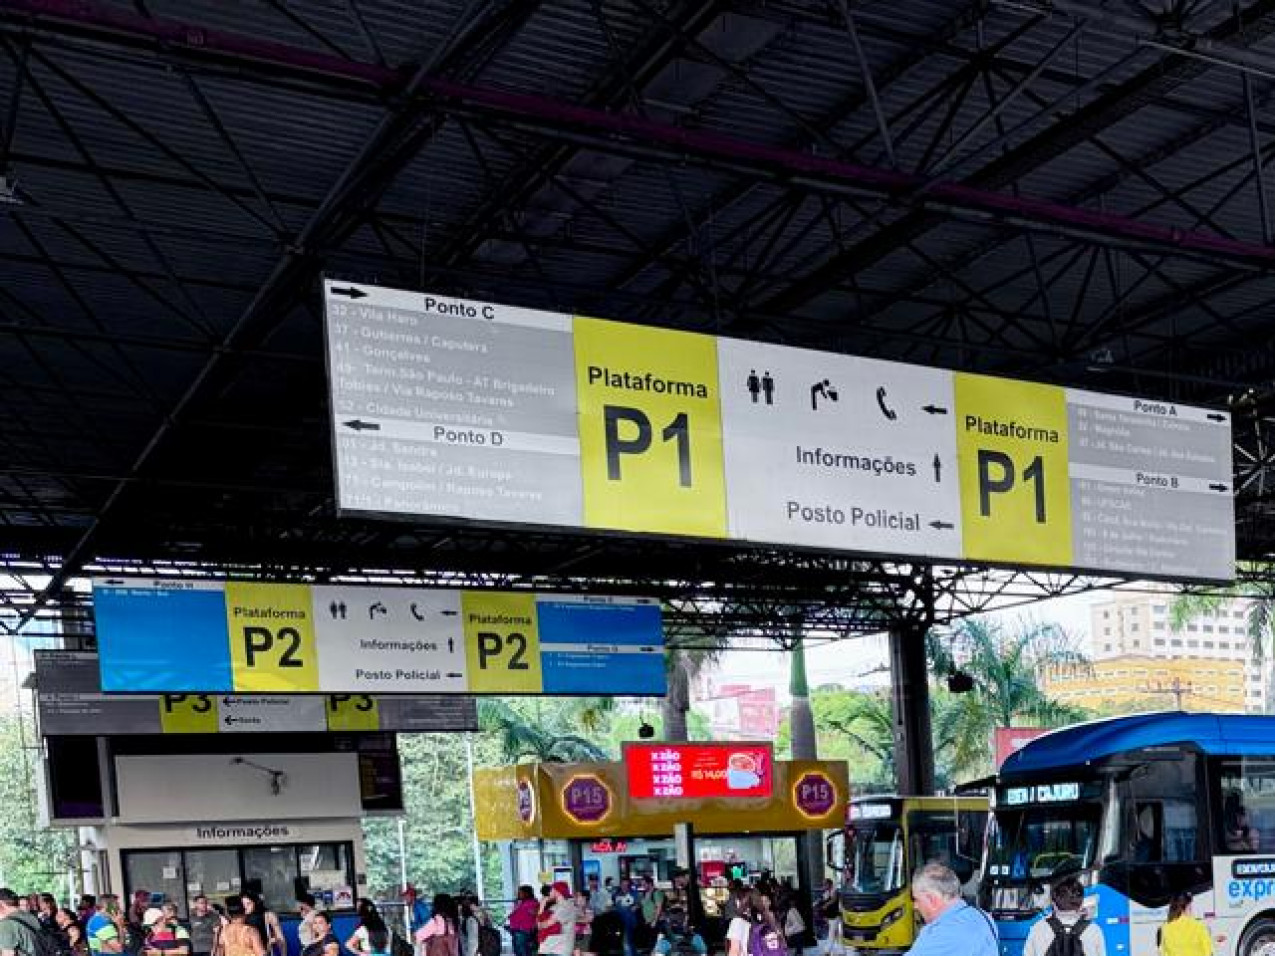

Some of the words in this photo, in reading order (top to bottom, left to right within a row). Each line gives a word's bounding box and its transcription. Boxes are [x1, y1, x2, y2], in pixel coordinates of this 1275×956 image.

[425, 297, 477, 318] Ponto
[482, 305, 495, 320] C
[588, 366, 709, 399] Plataforma
[1133, 400, 1167, 415] Ponto
[433, 425, 485, 445] Ponto
[491, 431, 503, 445] D
[965, 414, 1060, 444] Plataforma
[603, 403, 692, 488] P1
[796, 445, 917, 477] Informações
[977, 448, 1047, 523] P1
[1136, 473, 1168, 487] Ponto
[788, 501, 845, 527] Posto
[851, 507, 920, 531] Policial
[234, 606, 306, 619] Plataforma
[469, 614, 532, 625] Plataforma
[243, 626, 304, 668] P2
[360, 638, 437, 652] Informações
[477, 631, 529, 670] P2
[355, 669, 392, 680] Posto
[396, 669, 440, 680] Policial
[165, 695, 211, 713] P3
[331, 694, 373, 712] P3
[571, 786, 604, 804] P15
[802, 784, 829, 800] P15
[196, 824, 290, 840] Informações
